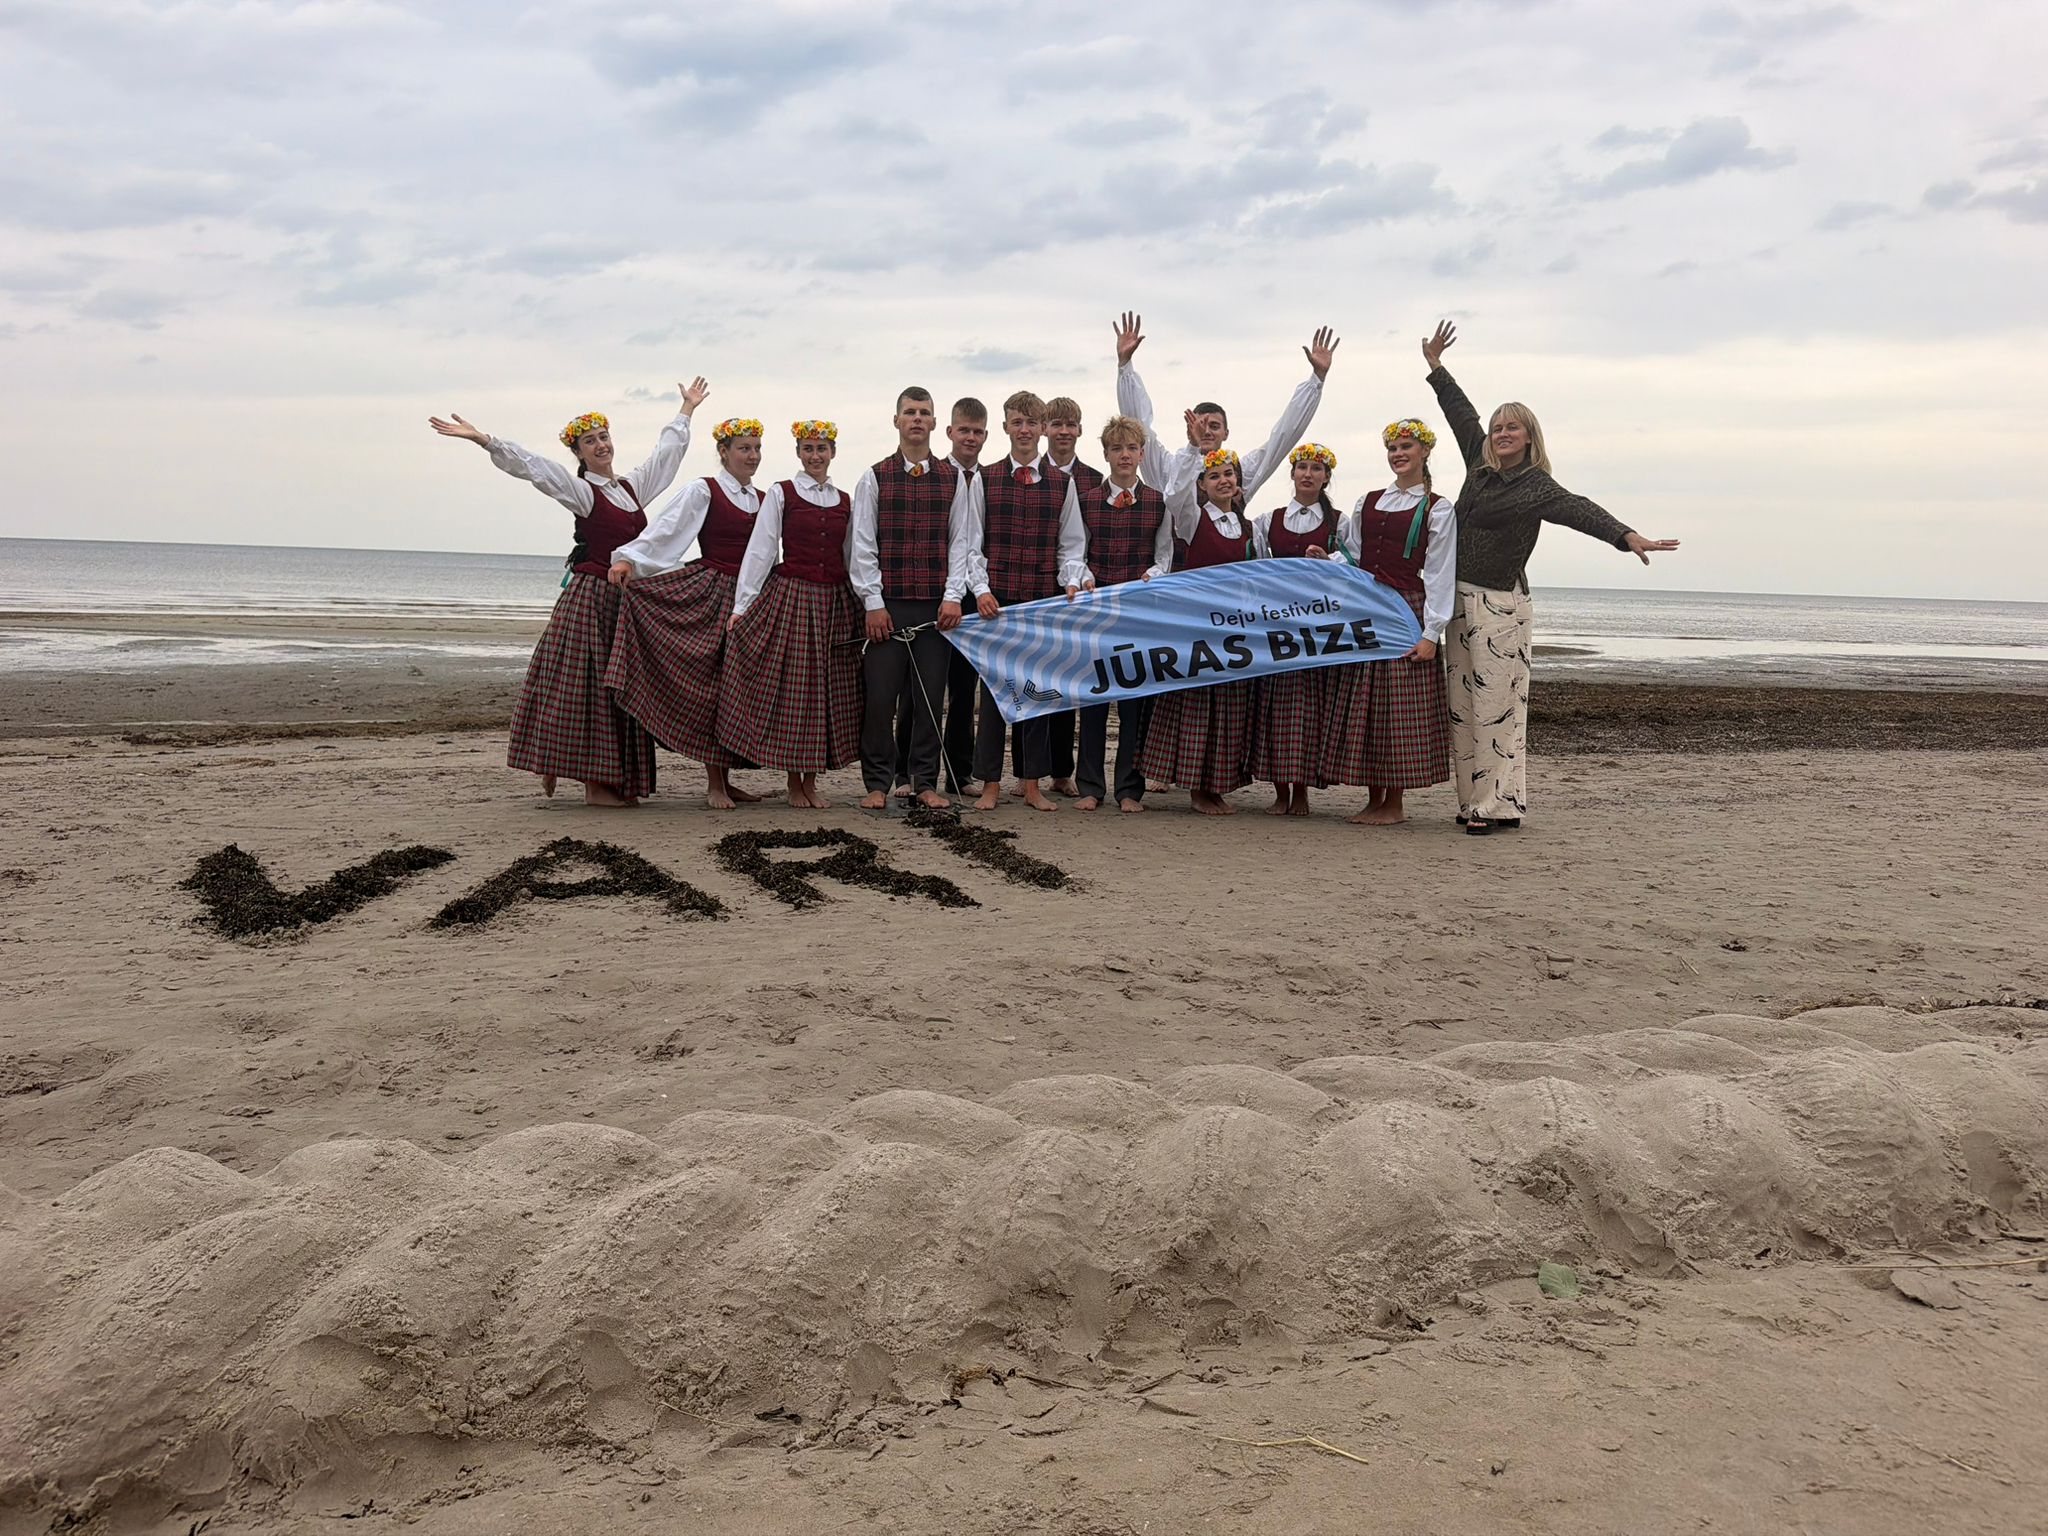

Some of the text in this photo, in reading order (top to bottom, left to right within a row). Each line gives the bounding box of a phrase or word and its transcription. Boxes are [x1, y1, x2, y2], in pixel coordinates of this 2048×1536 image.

[1210, 595, 1341, 628] Deju festivāls
[1090, 618, 1381, 694] JŪRAS BIZE
